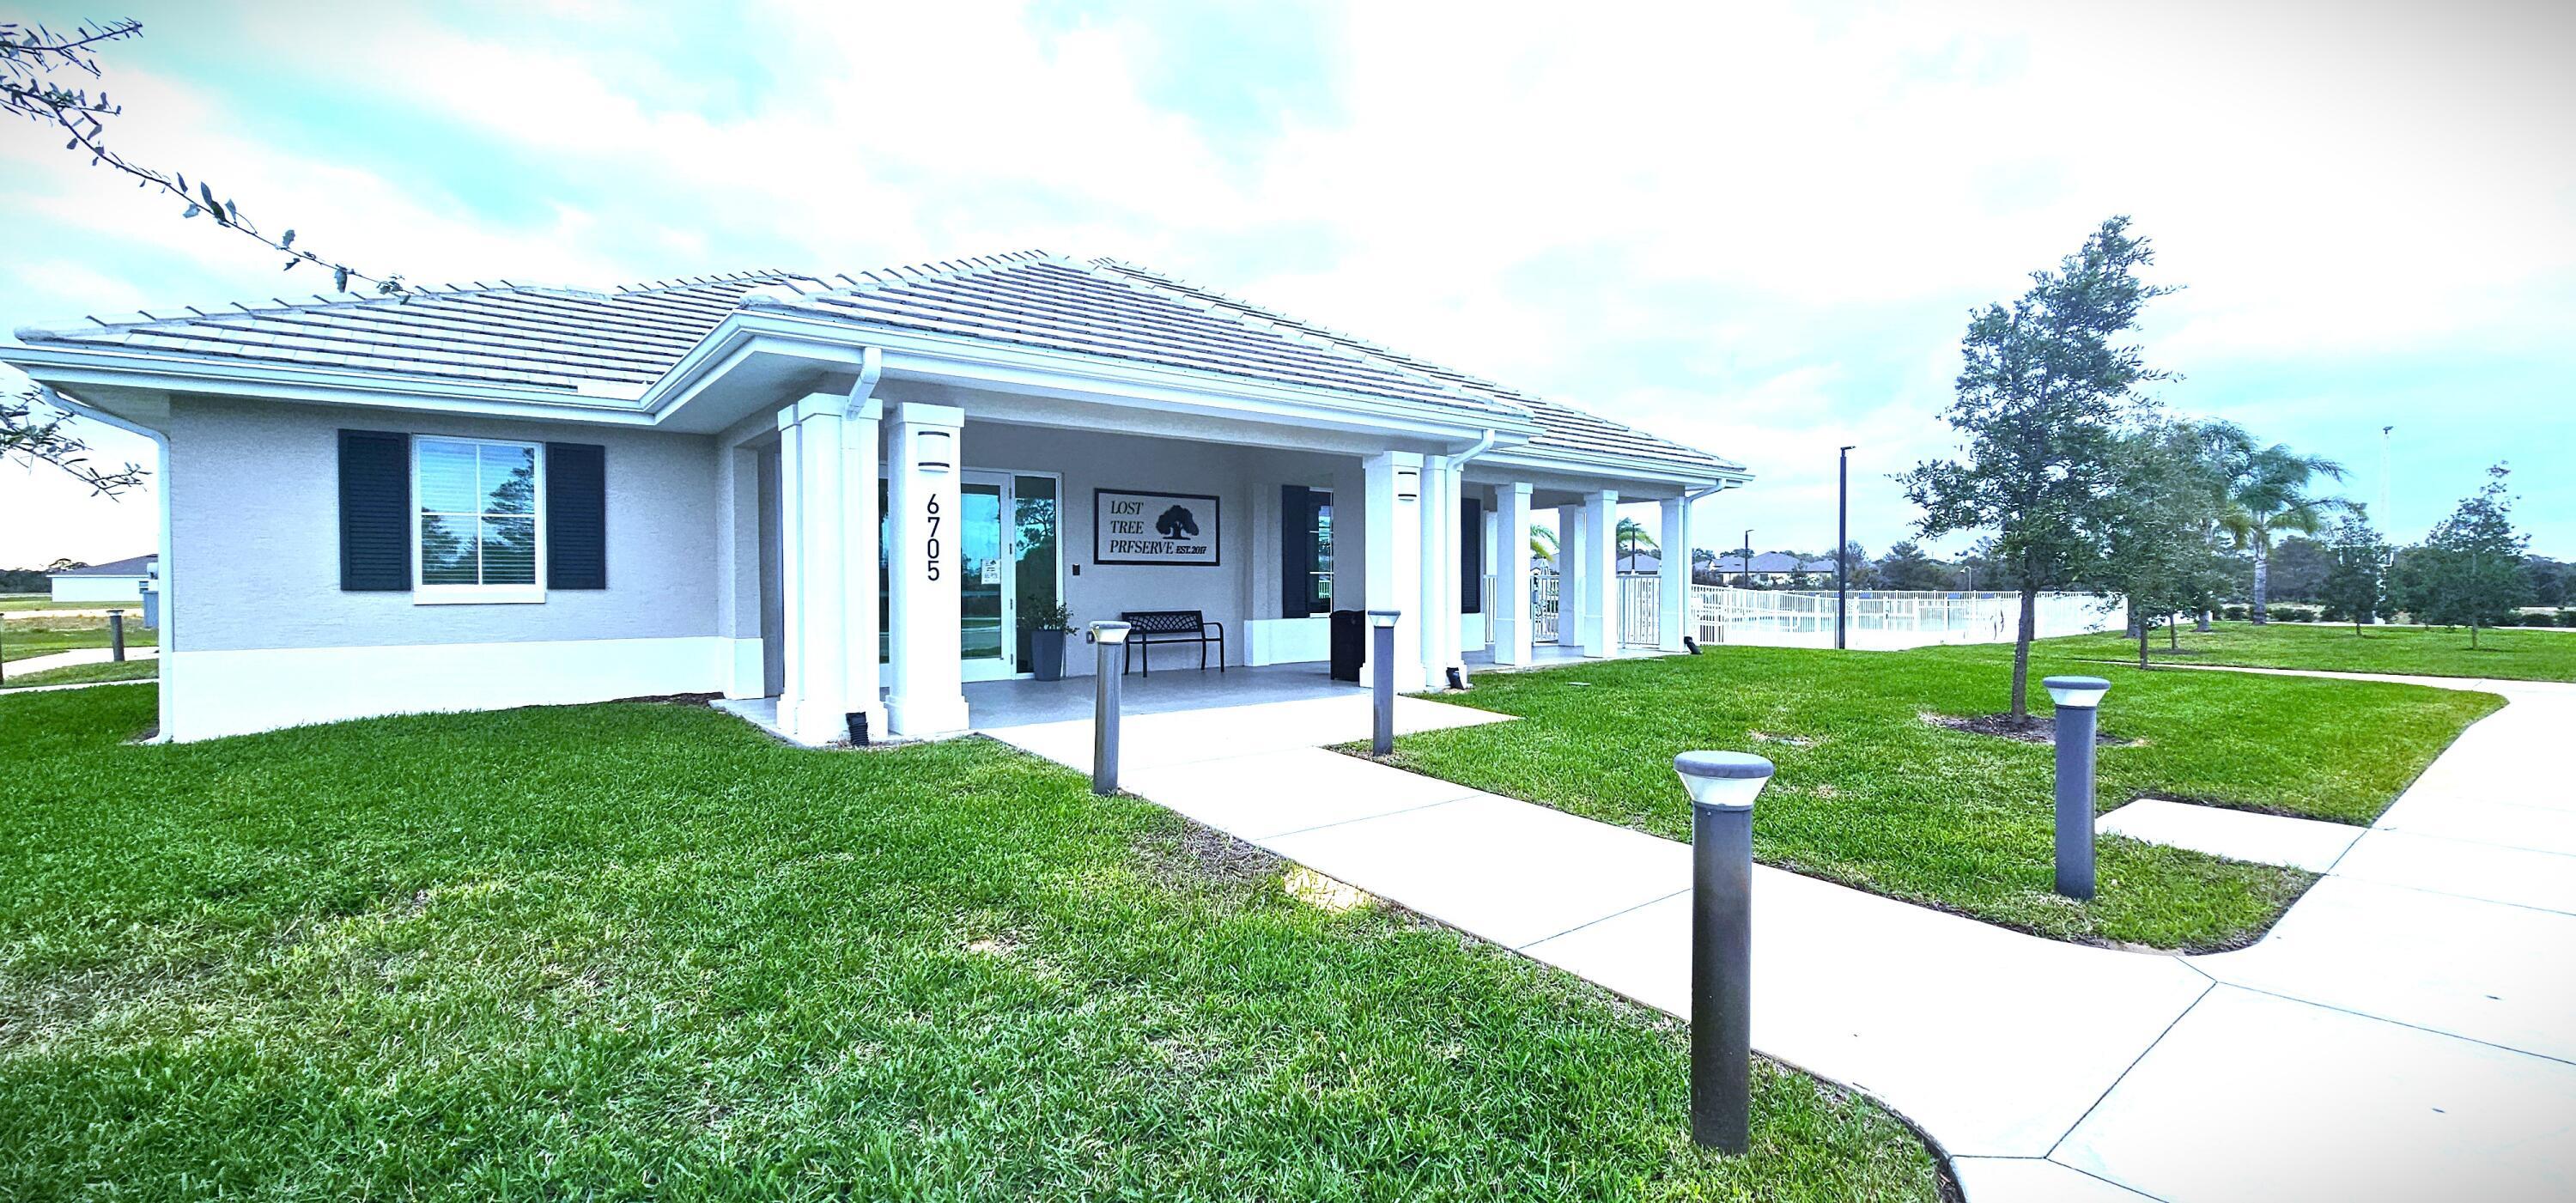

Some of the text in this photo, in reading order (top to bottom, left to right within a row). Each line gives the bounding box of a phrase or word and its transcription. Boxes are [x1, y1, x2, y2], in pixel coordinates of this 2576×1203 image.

[1111, 501, 1144, 514] LOST
[1110, 520, 1144, 534] TREE
[927, 494, 940, 581] 6705
